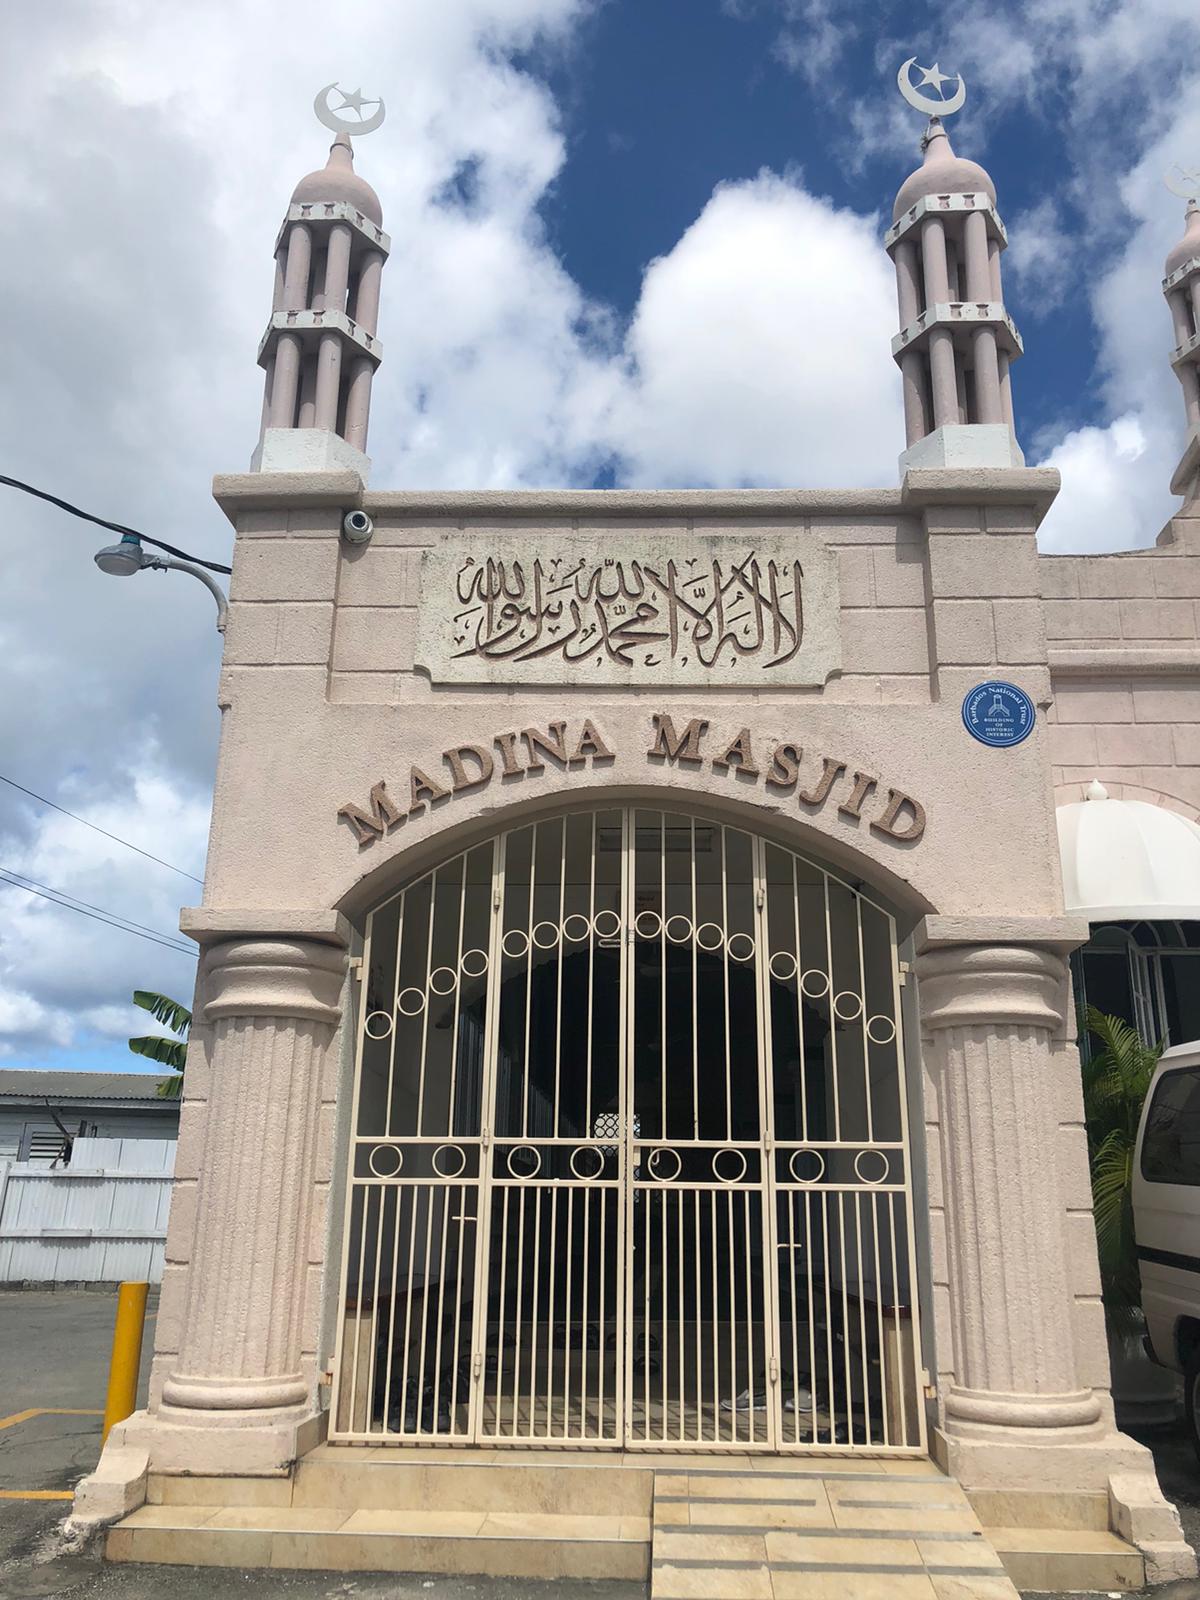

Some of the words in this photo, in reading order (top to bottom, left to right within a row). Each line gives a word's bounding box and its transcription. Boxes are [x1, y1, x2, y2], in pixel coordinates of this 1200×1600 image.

[969, 691, 987, 725] Barbados
[988, 687, 1023, 705] National
[1020, 704, 1028, 726] Trust
[337, 718, 616, 848] MADINA
[646, 713, 927, 842] MASJID
